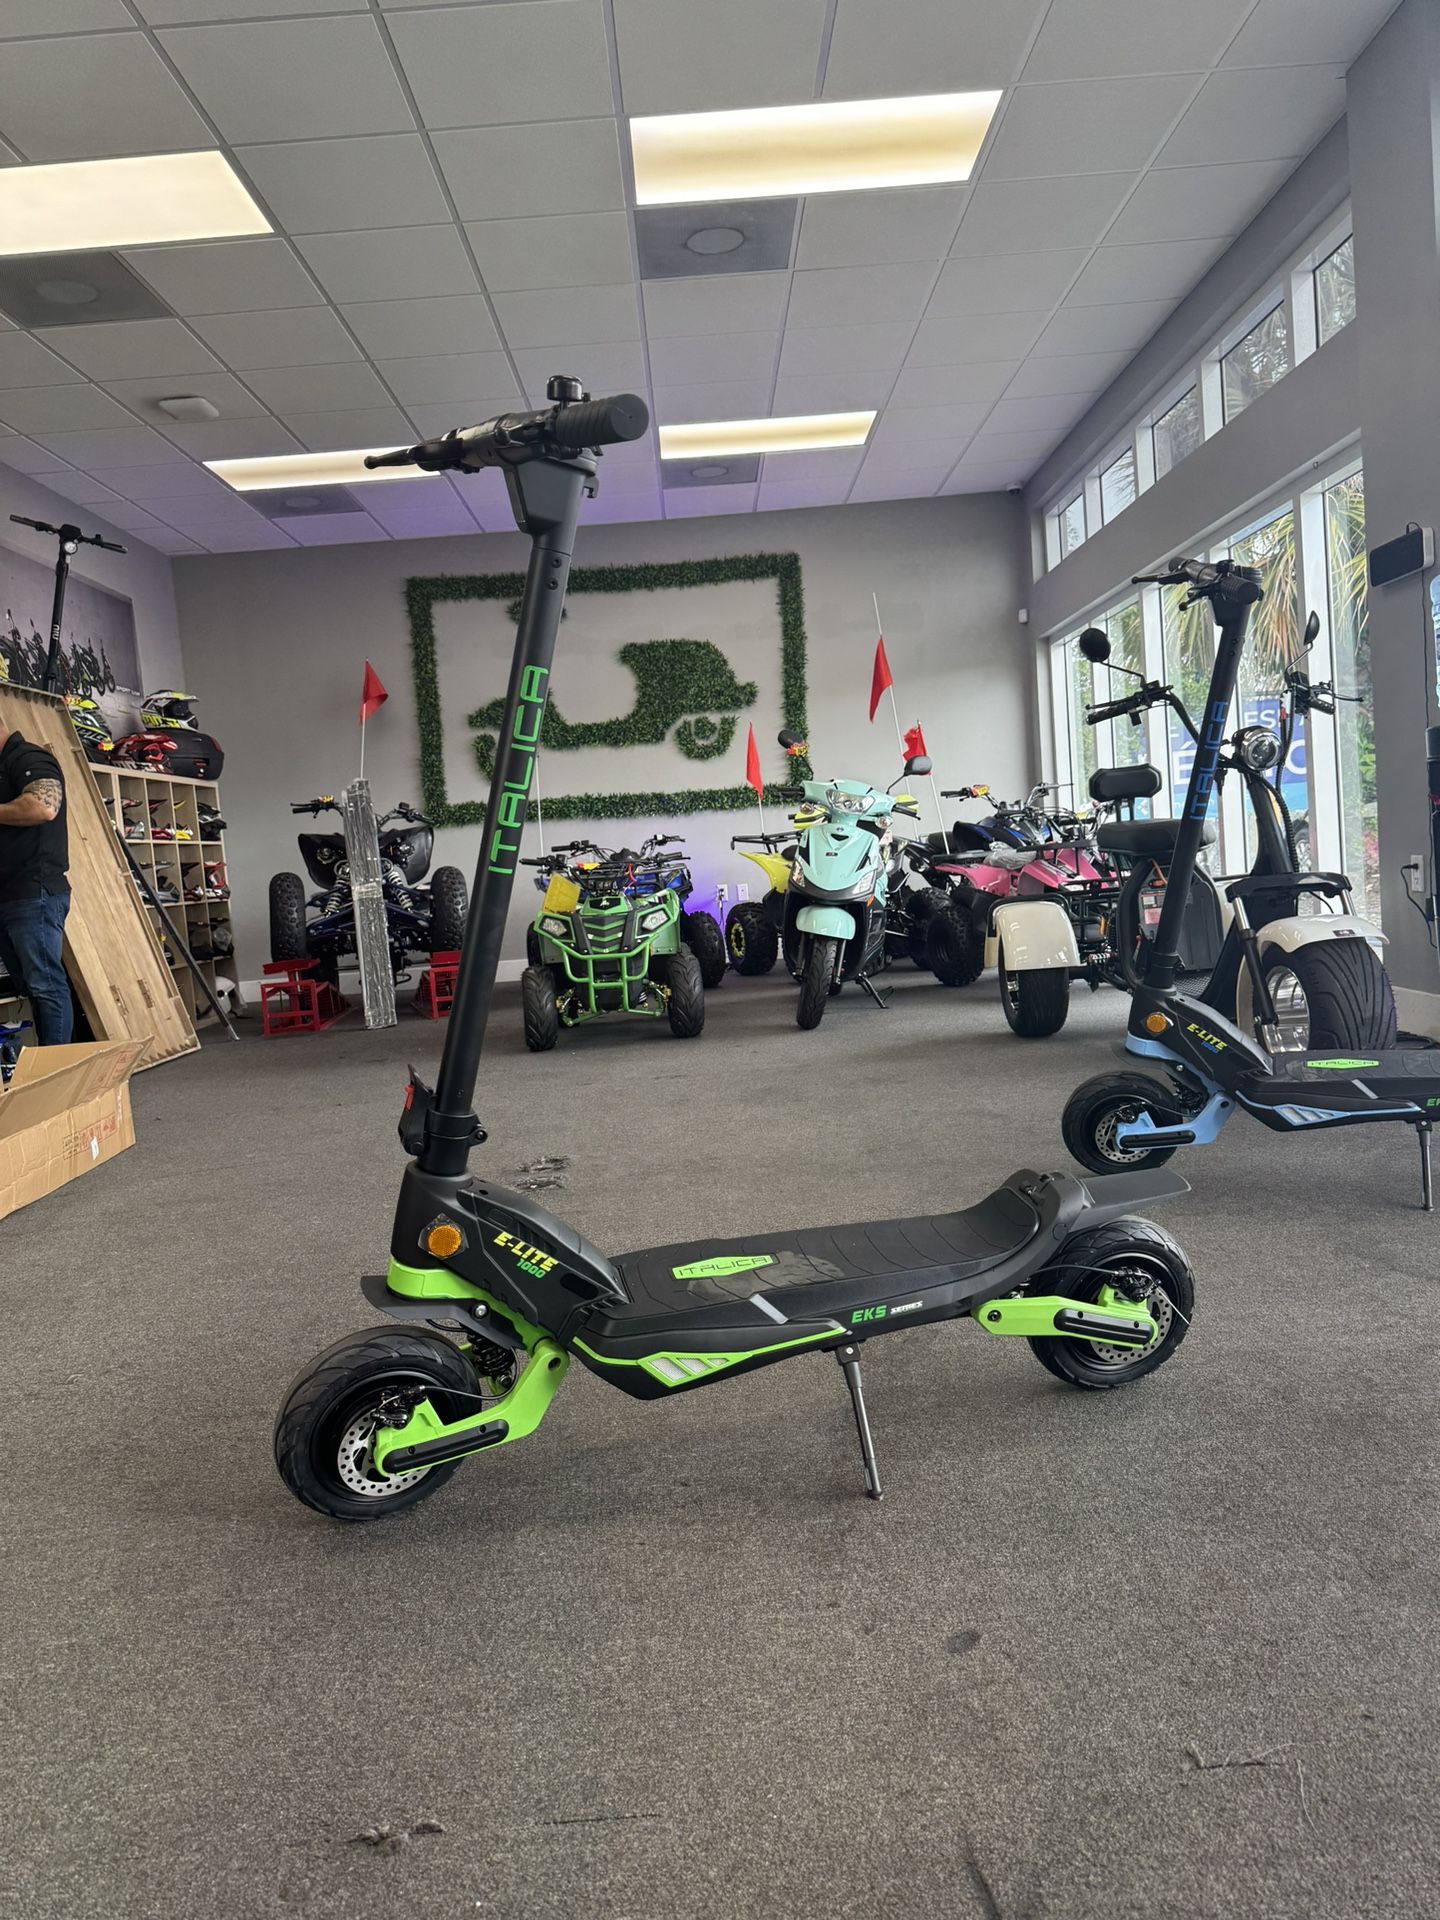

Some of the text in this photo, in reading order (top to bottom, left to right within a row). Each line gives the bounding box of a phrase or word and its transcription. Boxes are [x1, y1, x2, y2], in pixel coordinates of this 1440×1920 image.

[488, 664, 549, 875] ITALICA
[1189, 701, 1228, 820] ITALICA
[1186, 1023, 1228, 1050] E-LITE
[493, 1231, 559, 1272] E-LITE
[517, 1259, 546, 1279] 1000
[678, 1257, 768, 1277] ITALICA
[851, 1304, 887, 1324] EKS
